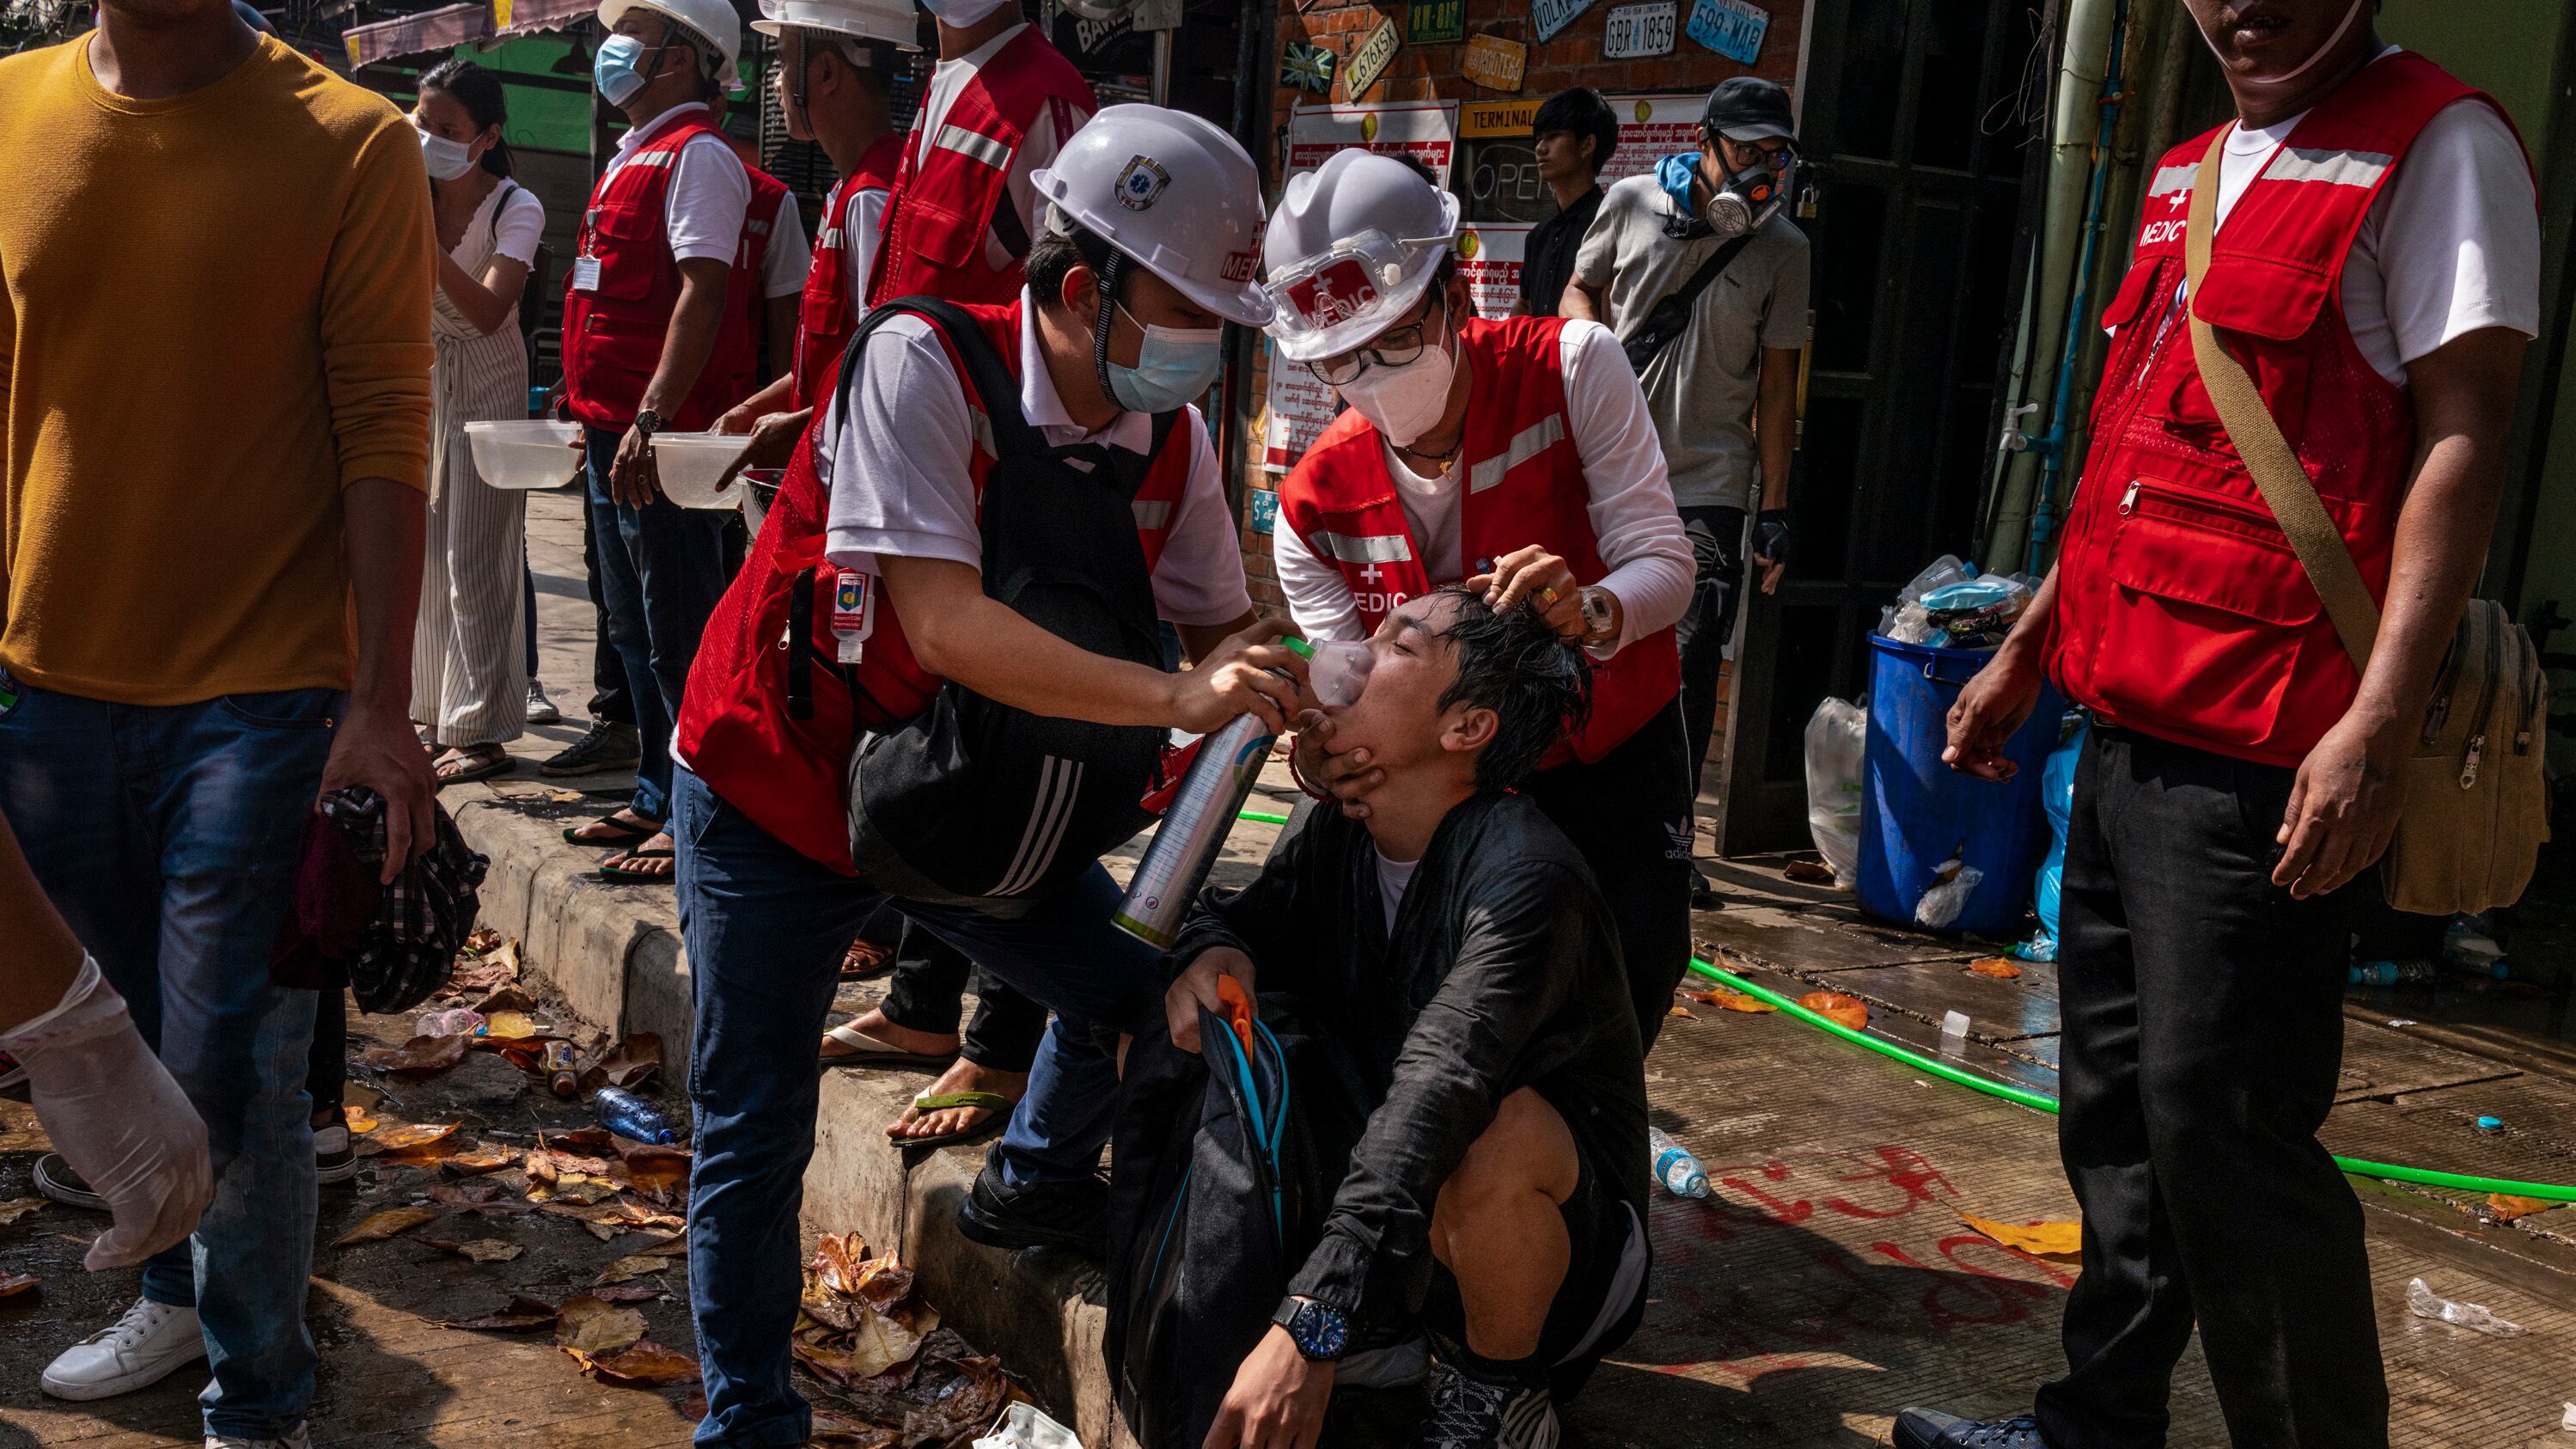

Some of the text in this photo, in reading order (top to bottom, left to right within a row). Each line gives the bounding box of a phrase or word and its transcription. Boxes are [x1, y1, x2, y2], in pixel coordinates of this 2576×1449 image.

[1608, 15, 1673, 52] GBR 1859
[1473, 109, 1534, 129] TERMINAL
[2139, 220, 2187, 247] MEDIC
[1353, 592, 1408, 613] EDIC
